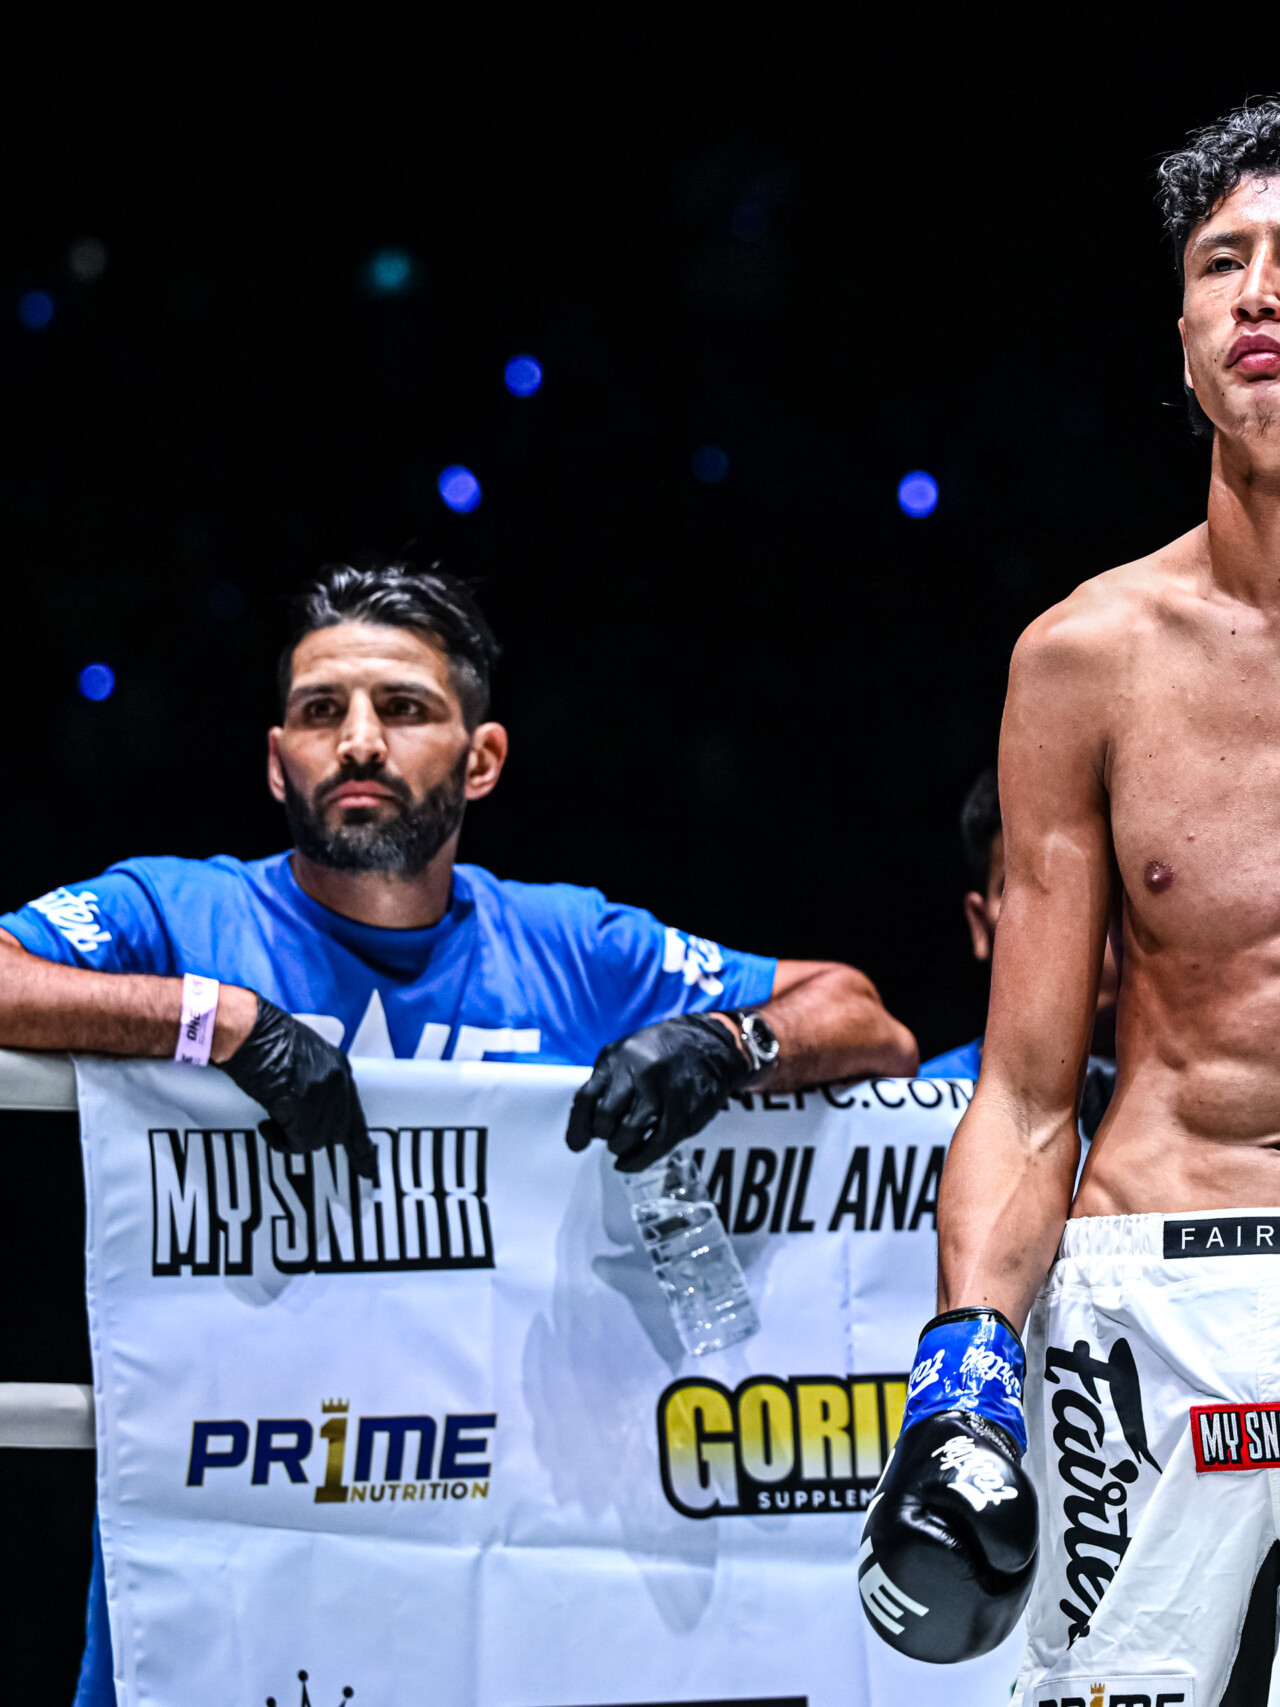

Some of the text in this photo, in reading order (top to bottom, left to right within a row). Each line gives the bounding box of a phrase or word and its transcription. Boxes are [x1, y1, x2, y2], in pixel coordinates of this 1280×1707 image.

[692, 1145, 817, 1234] ABIL
[1199, 1411, 1243, 1465] MY
[351, 1481, 490, 1503] NUTRITION
